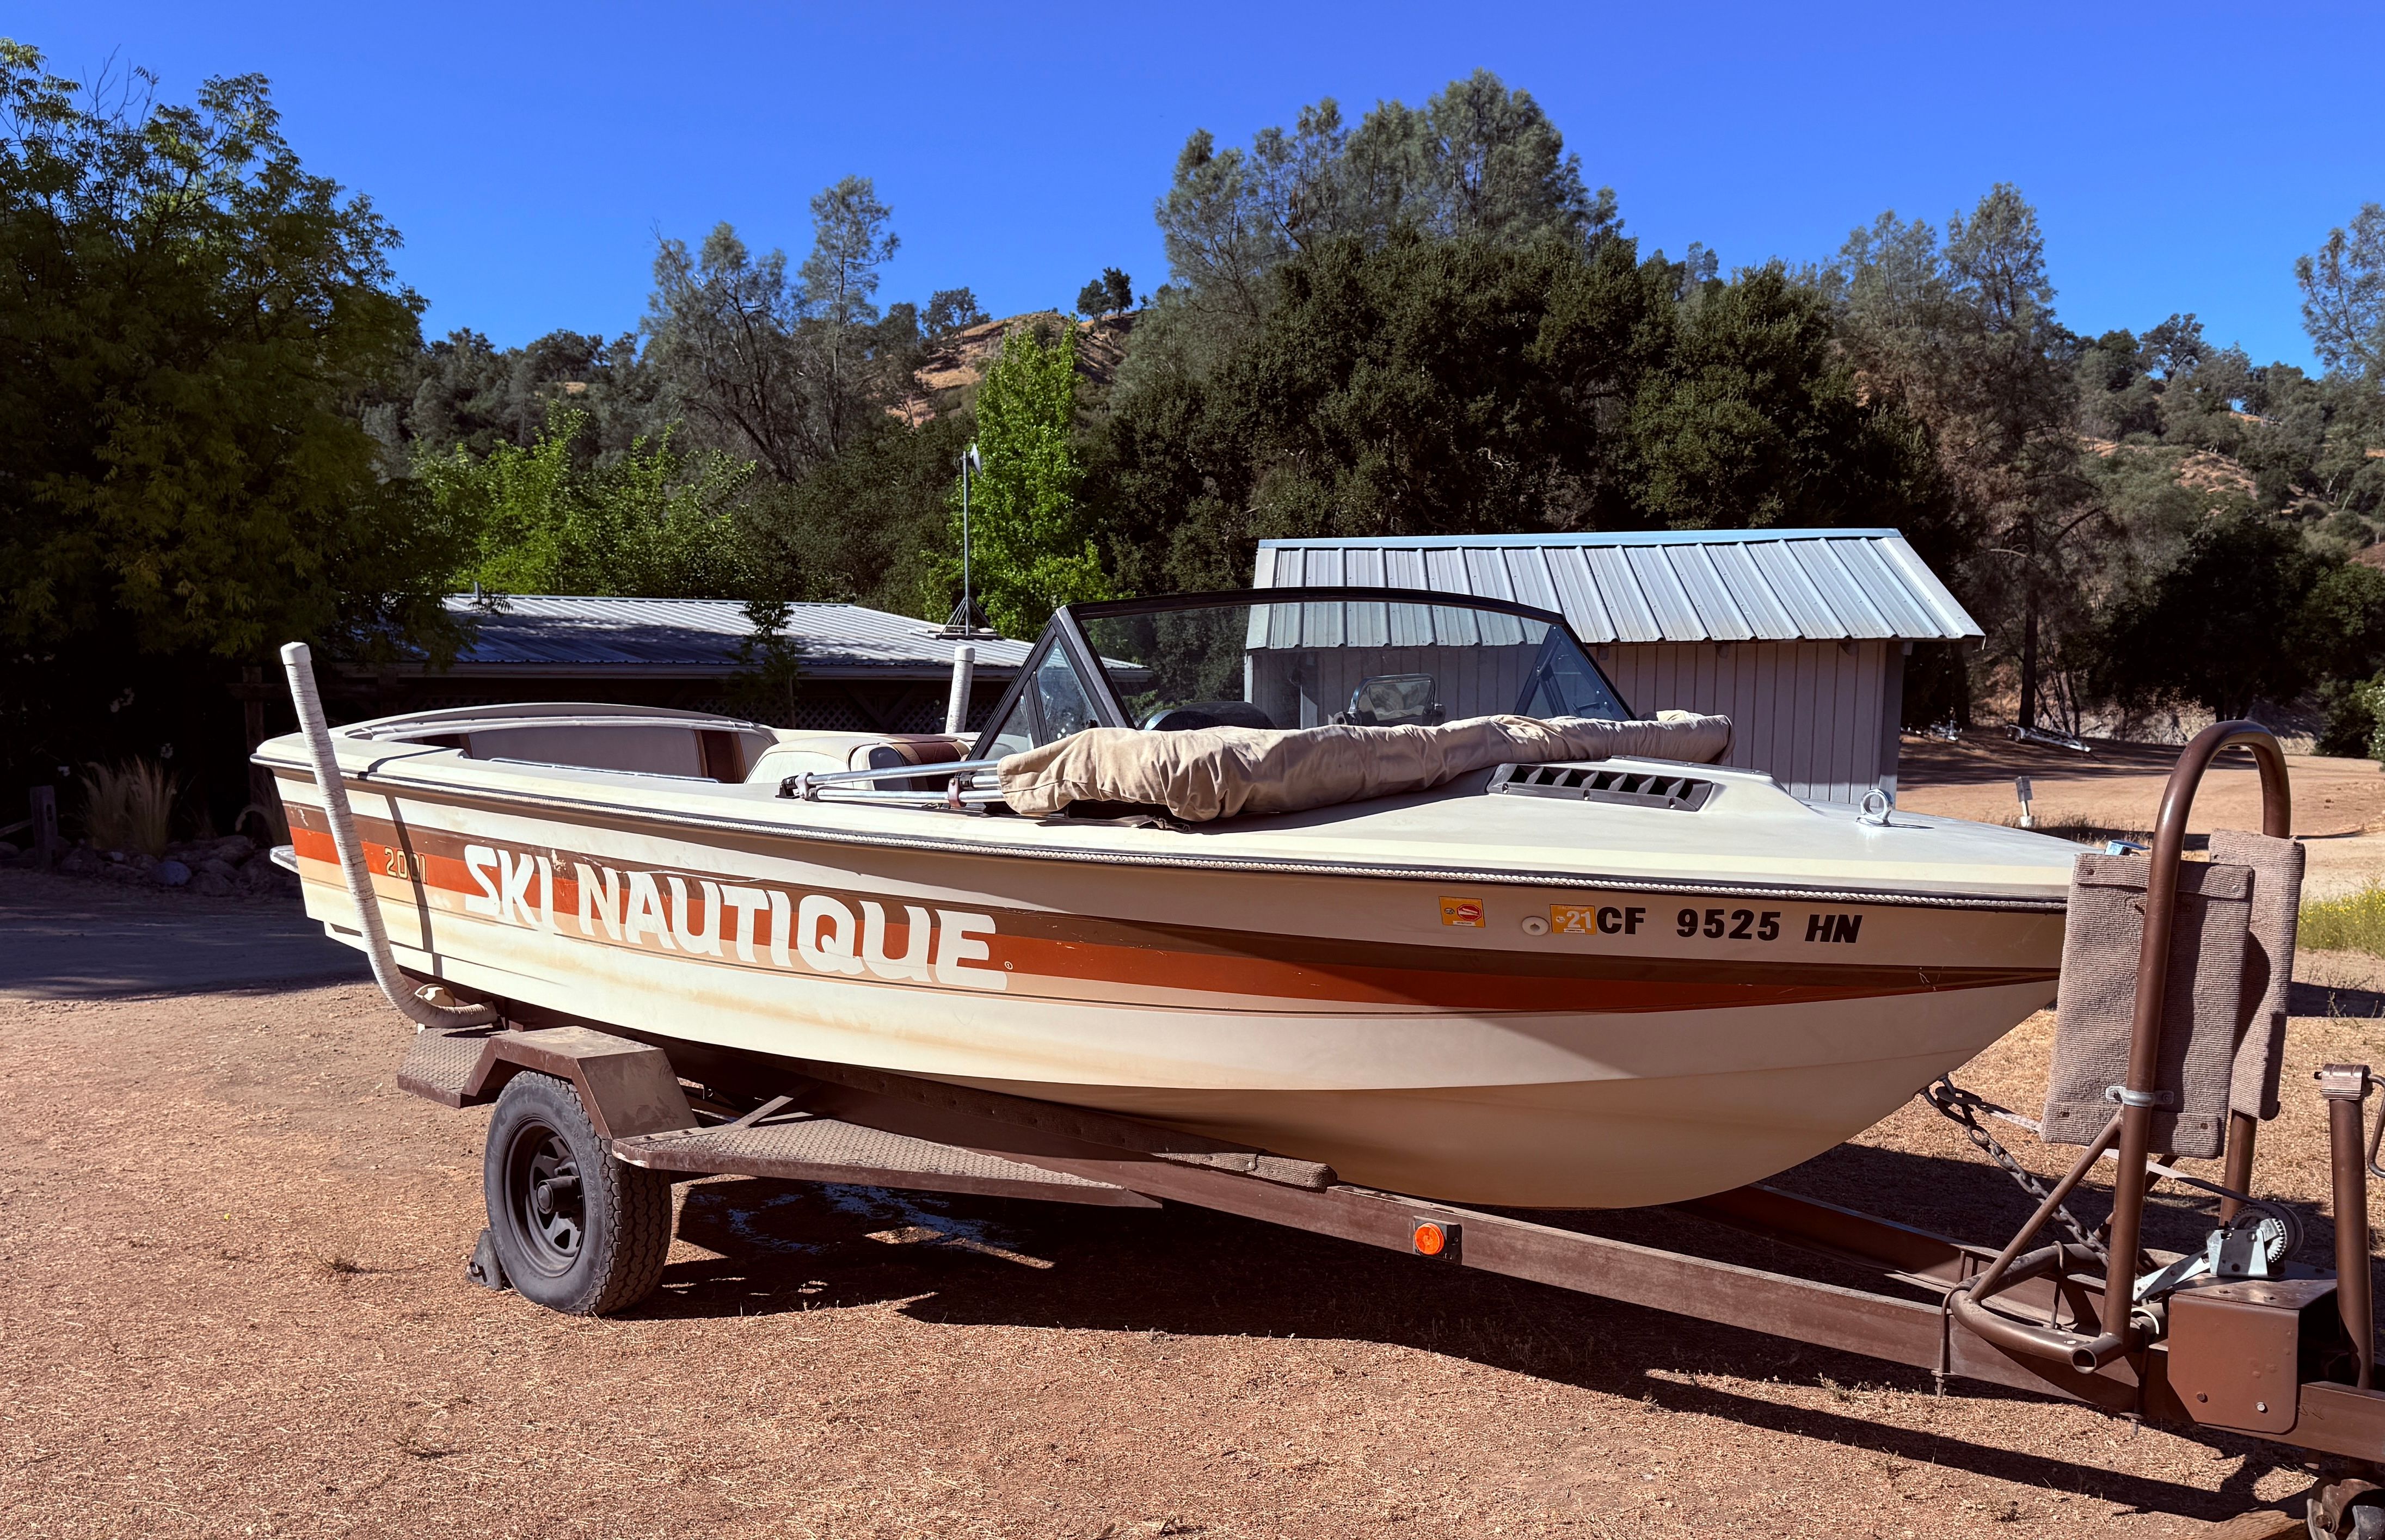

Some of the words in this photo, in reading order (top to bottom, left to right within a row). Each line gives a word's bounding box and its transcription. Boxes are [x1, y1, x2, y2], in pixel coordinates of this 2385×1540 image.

[384, 847, 427, 884] 2001
[464, 845, 563, 933] SKI
[573, 862, 1007, 990] NAUTIQUE
[1566, 910, 1591, 929] 21
[1596, 907, 1646, 935] CF
[1676, 909, 1781, 941] 9525
[1804, 914, 1862, 944] HN
